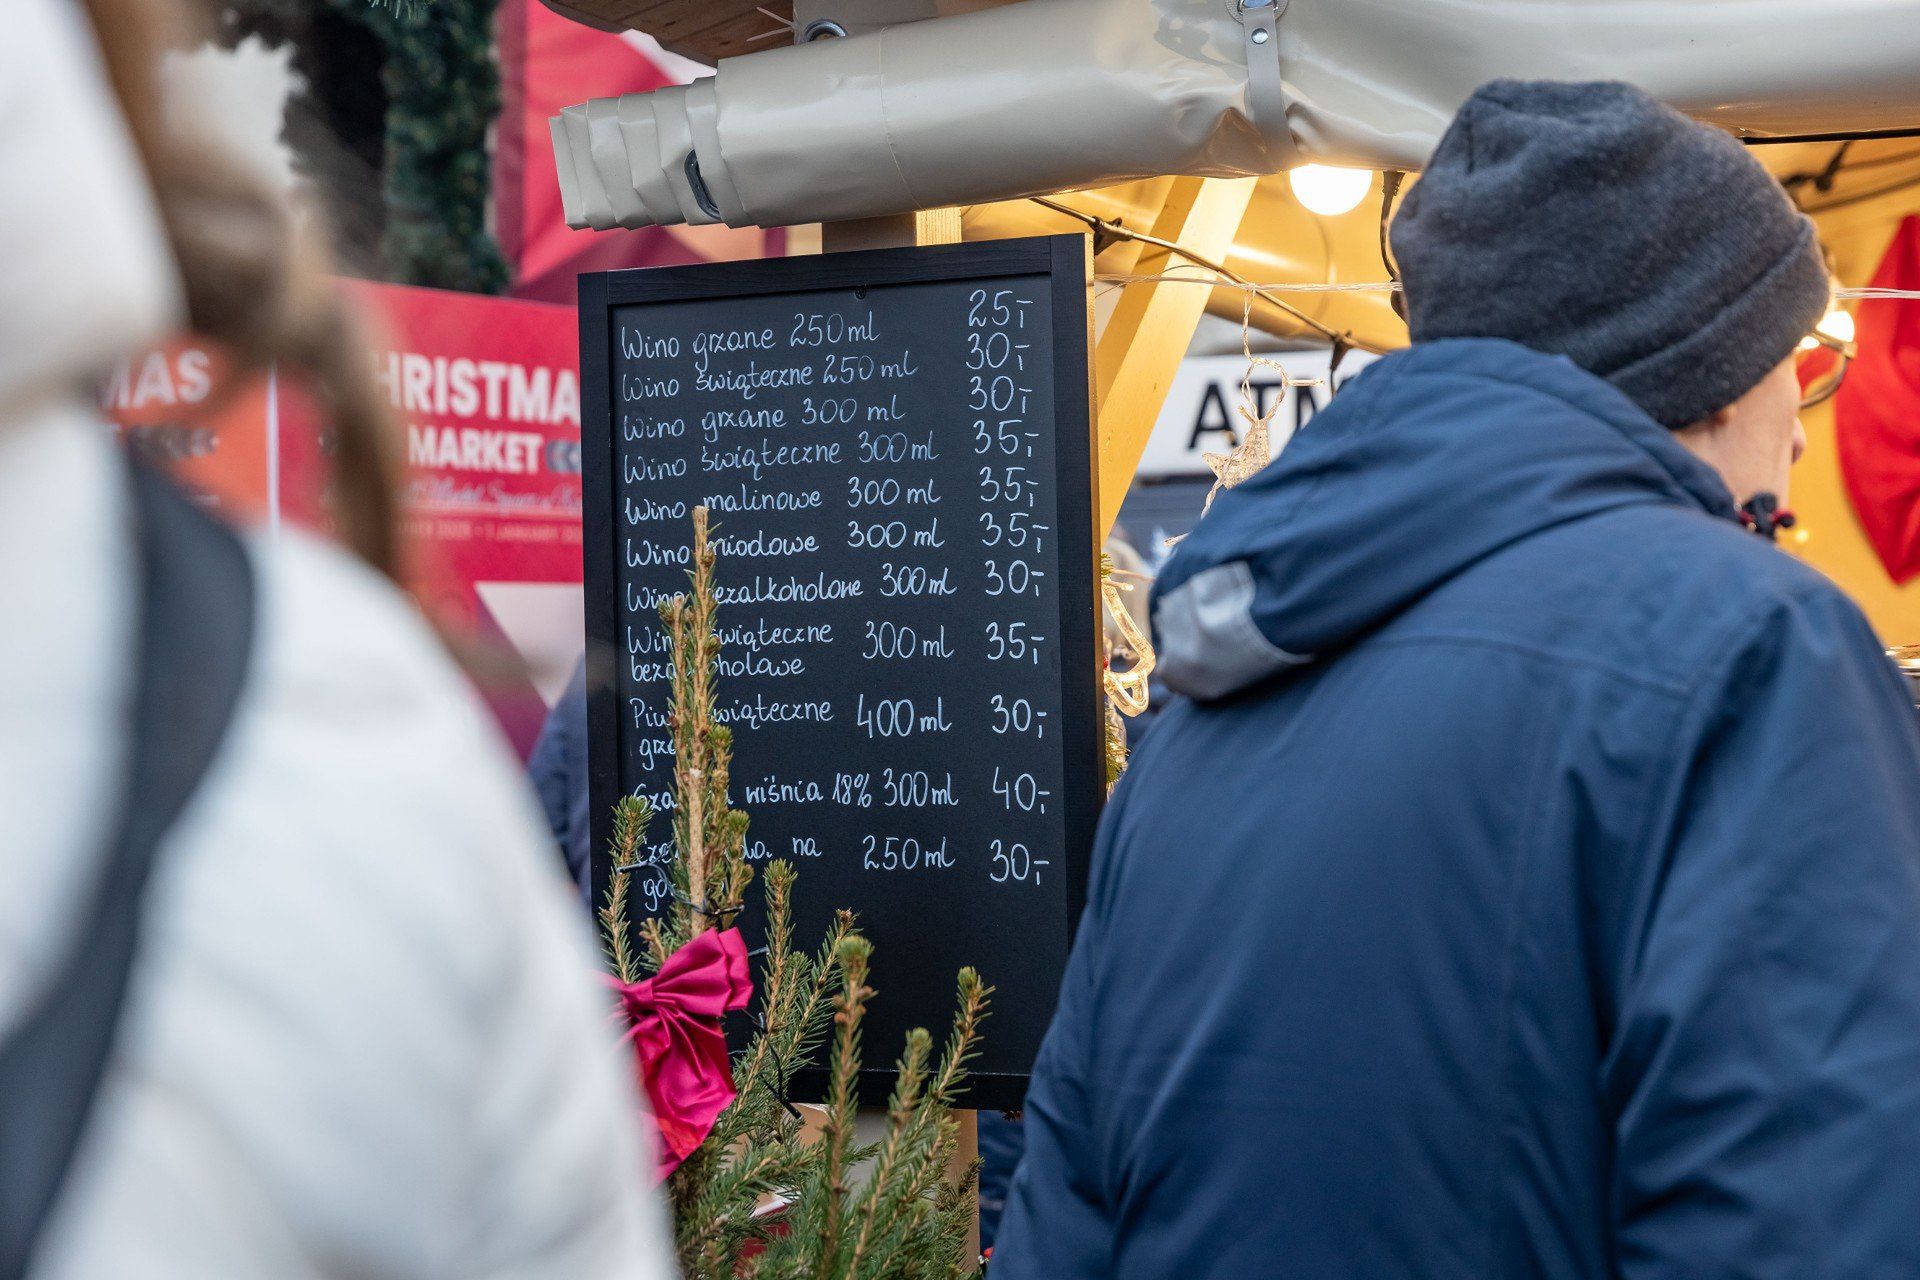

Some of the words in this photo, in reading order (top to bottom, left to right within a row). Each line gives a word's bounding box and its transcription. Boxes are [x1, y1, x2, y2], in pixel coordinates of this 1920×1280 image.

[621, 326, 680, 360] Wino
[692, 328, 776, 372] grzane
[374, 349, 581, 427] HRISTMA
[622, 373, 680, 402] Wino
[695, 360, 814, 400] świąteczne
[623, 414, 685, 442] Wino
[701, 409, 787, 443] grzane
[408, 423, 544, 475] MARKET
[624, 454, 687, 484] Wino
[701, 438, 843, 481] świąteczne
[625, 497, 686, 525] Wino
[703, 483, 823, 512] malinowe
[626, 538, 690, 568] Wino
[627, 625, 675, 655] Win
[629, 697, 675, 729] Piw
[706, 693, 835, 730] wiąteczne
[832, 772, 873, 808] 18%
[792, 837, 822, 857] na
